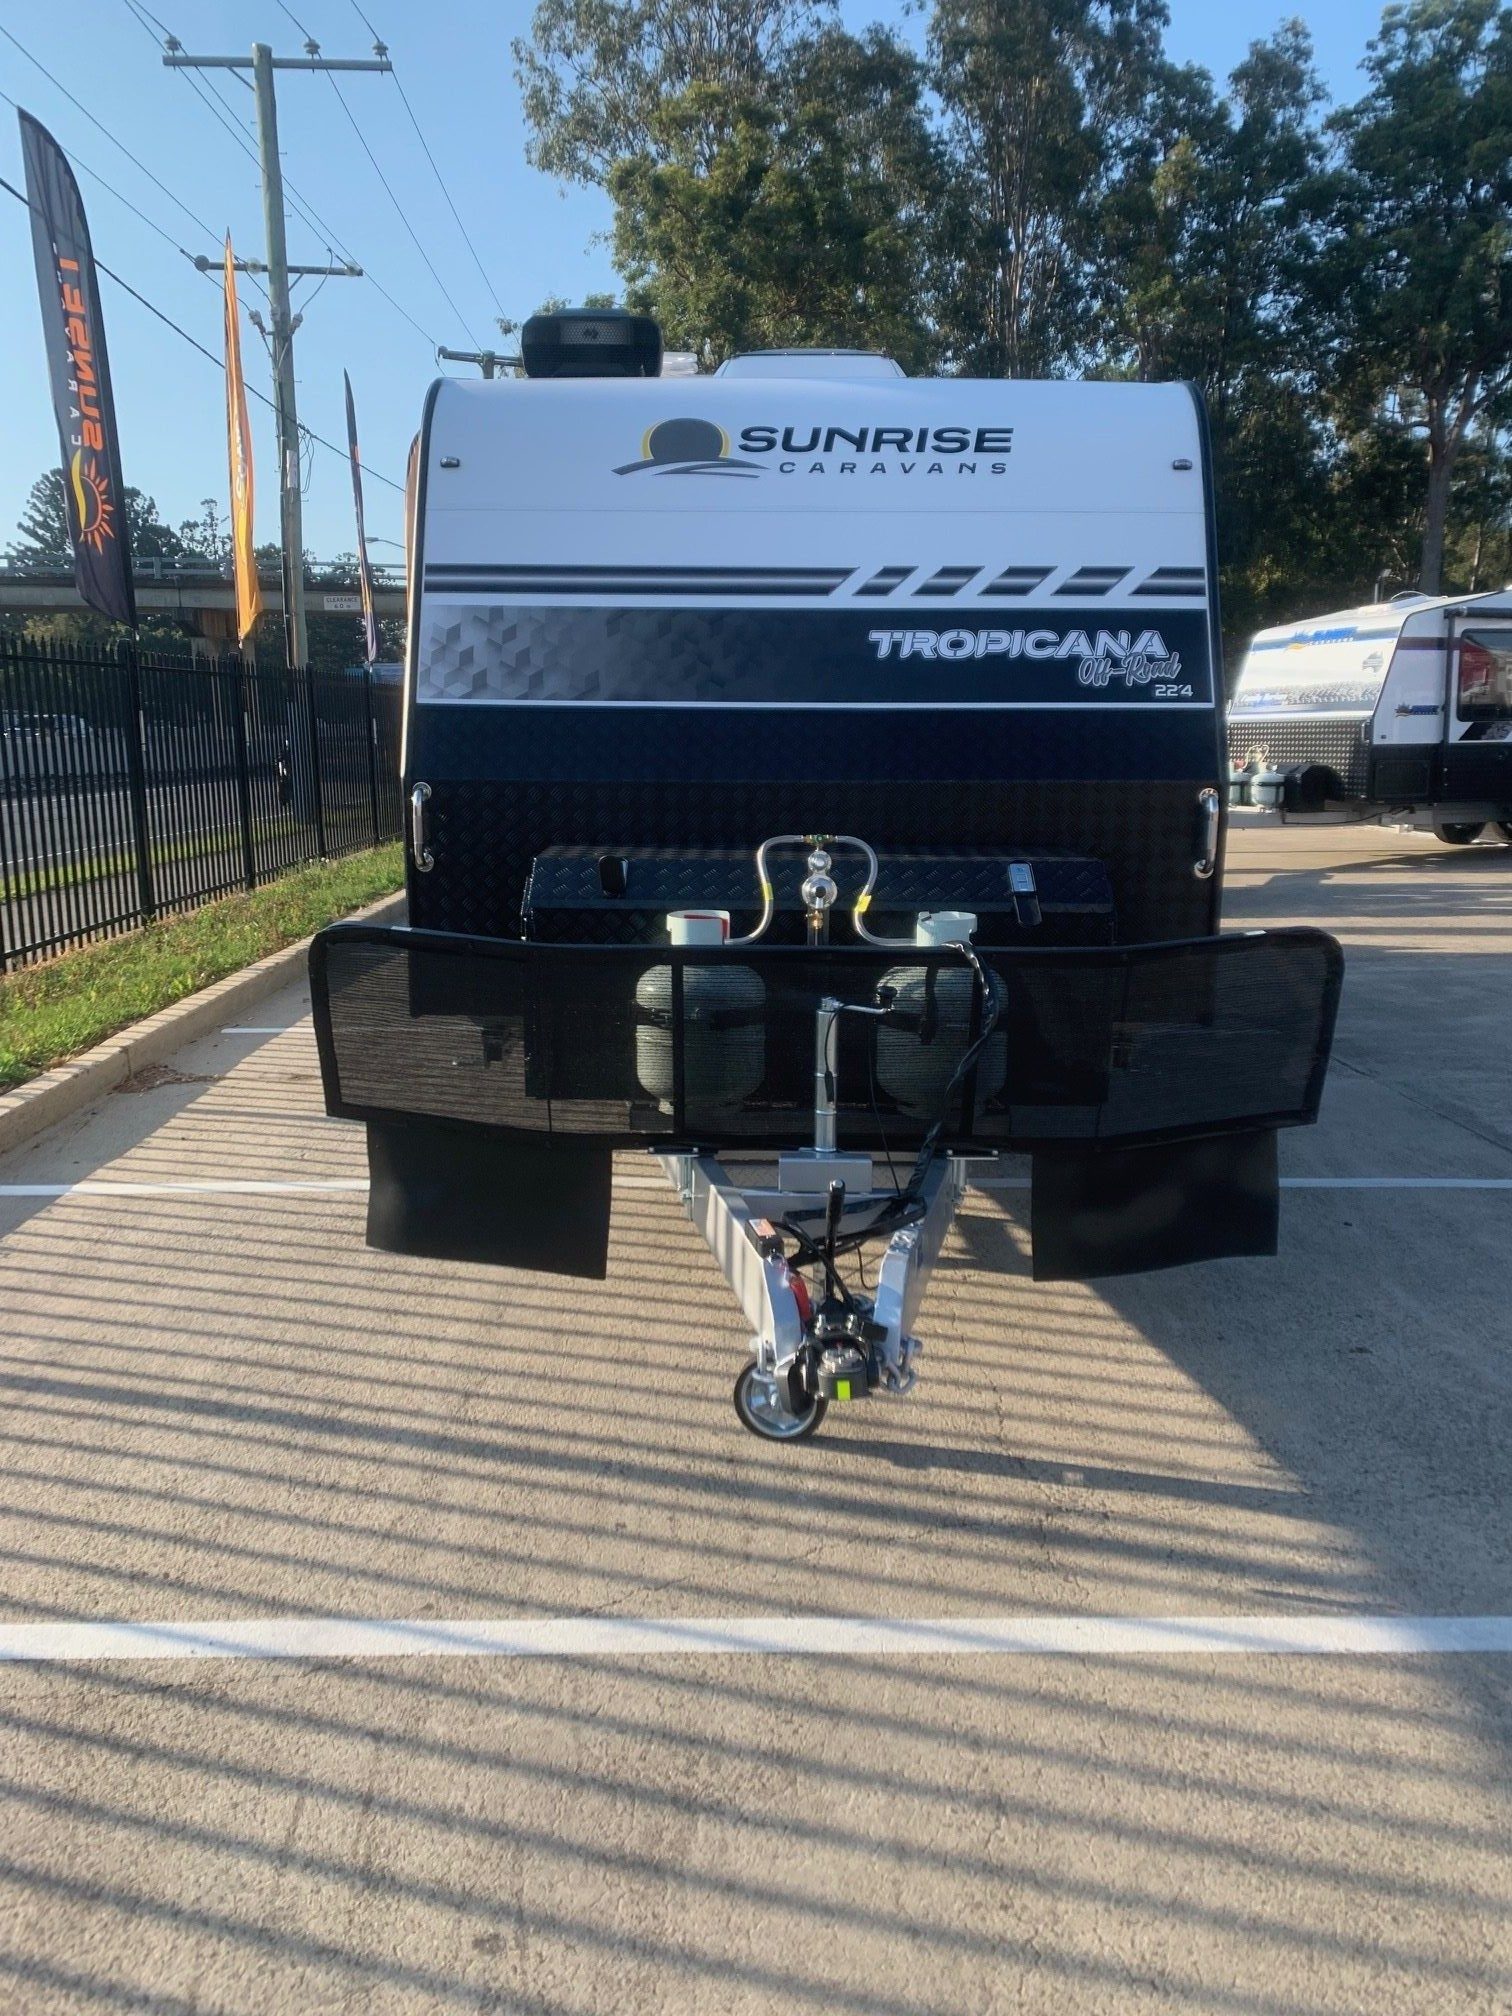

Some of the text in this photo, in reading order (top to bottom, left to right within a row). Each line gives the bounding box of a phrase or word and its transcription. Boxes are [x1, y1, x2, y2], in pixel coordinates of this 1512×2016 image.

[738, 426, 1014, 453] SUNRISE
[779, 461, 1007, 474] CARAVANS
[869, 629, 1169, 659] TROPICANA
[1079, 652, 1182, 686] Off-Road
